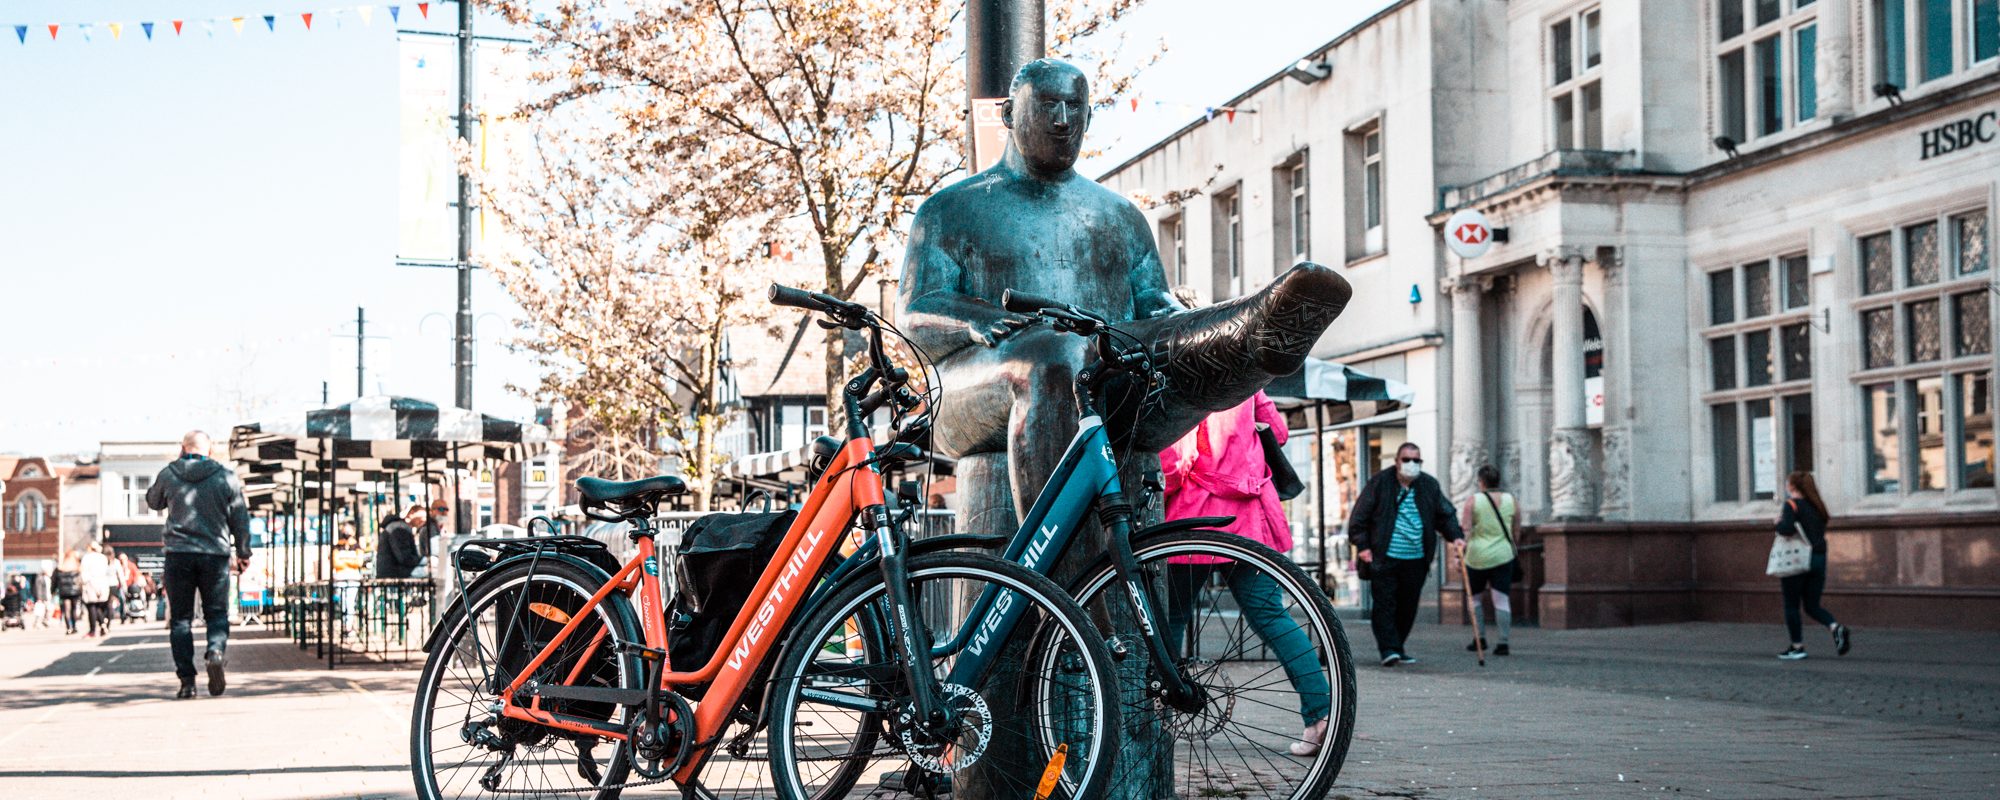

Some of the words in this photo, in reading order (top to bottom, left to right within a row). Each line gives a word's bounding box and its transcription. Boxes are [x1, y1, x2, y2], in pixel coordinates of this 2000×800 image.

[1919, 110, 1996, 160] HSBC
[728, 529, 824, 671] WESTHILL
[968, 524, 1059, 657] WESHILL
